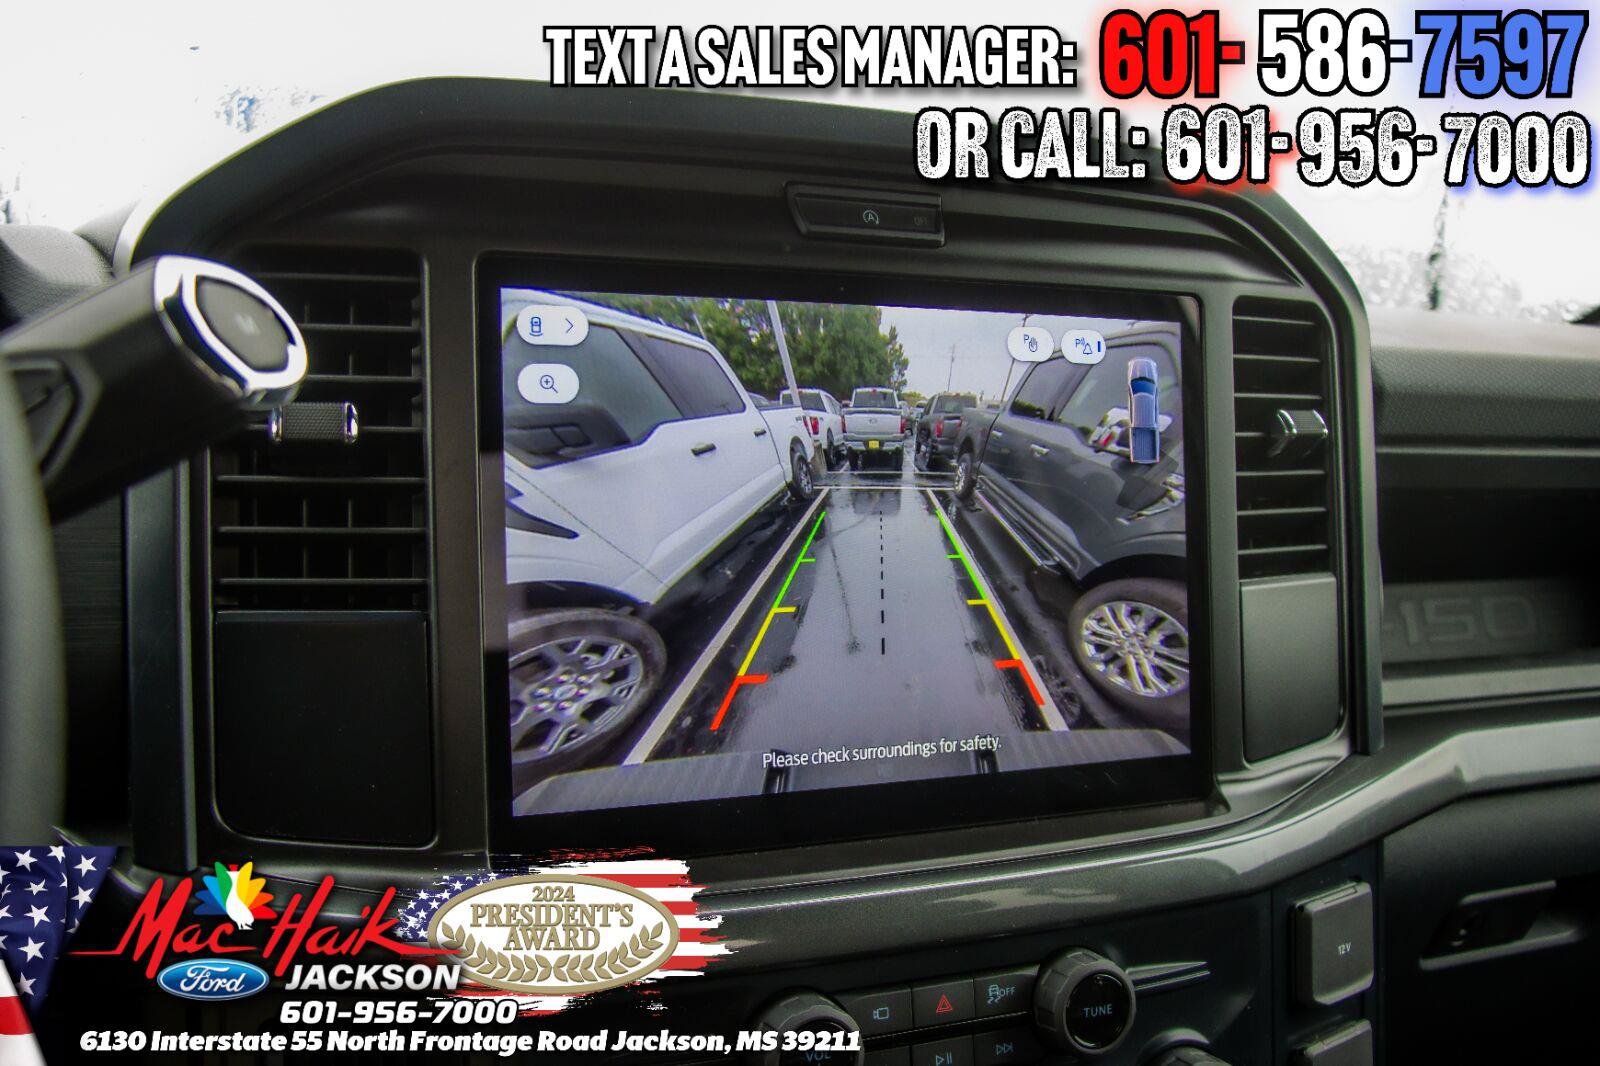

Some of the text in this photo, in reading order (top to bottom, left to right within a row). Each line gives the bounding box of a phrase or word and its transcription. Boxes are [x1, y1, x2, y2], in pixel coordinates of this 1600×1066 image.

[762, 734, 1003, 768] Please check surroundings for safety.
[999, 986, 1015, 997] OFF
[1084, 1004, 1113, 1017] TUNE
